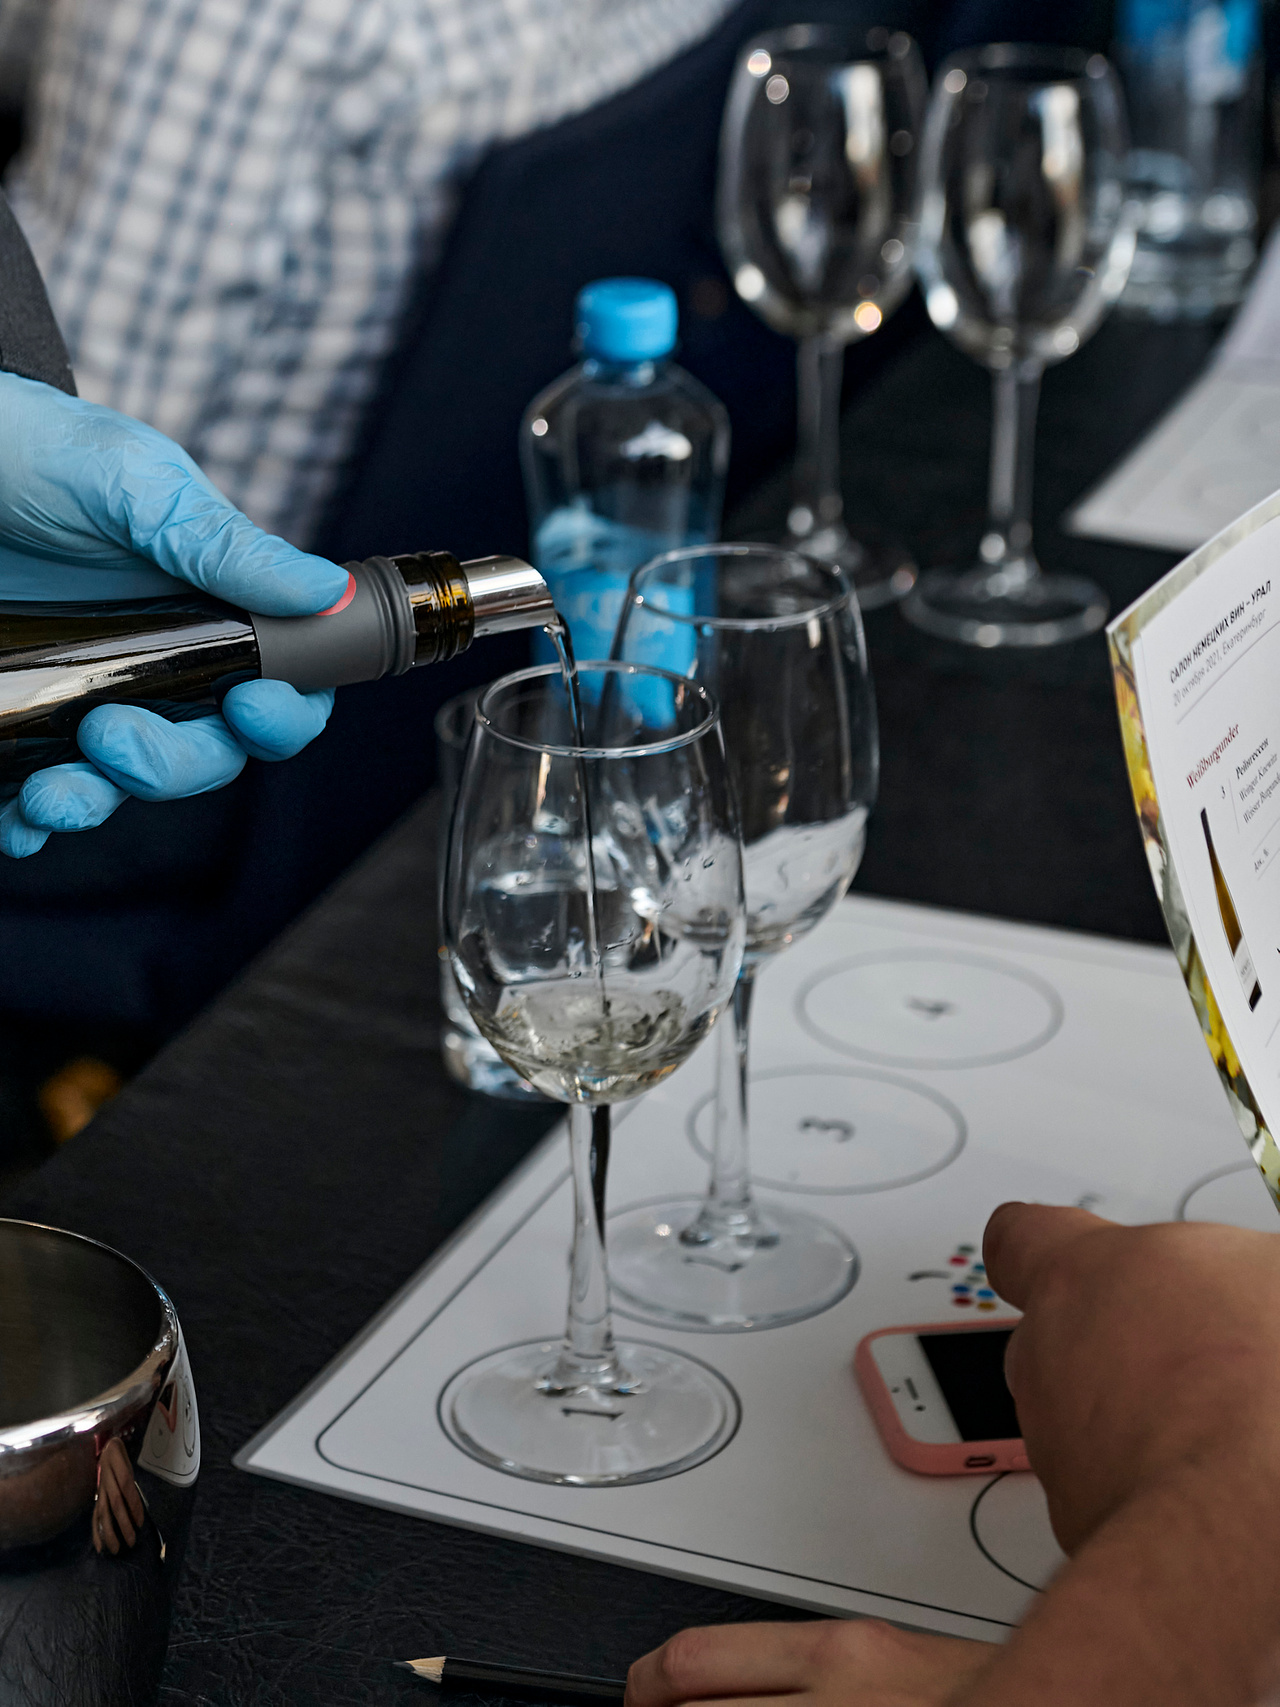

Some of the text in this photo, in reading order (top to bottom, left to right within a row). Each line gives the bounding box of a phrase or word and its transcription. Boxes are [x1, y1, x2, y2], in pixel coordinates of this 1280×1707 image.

[1170, 652, 1192, 683] САЛОН
[1193, 616, 1230, 660] НЕМЕЦКИХ
[1230, 601, 1245, 625] ВИН
[1251, 580, 1271, 605] УРАЛ
[1222, 608, 1267, 656] Екатеринбург
[797, 1115, 856, 1144] 3
[561, 1407, 623, 1421] 1
